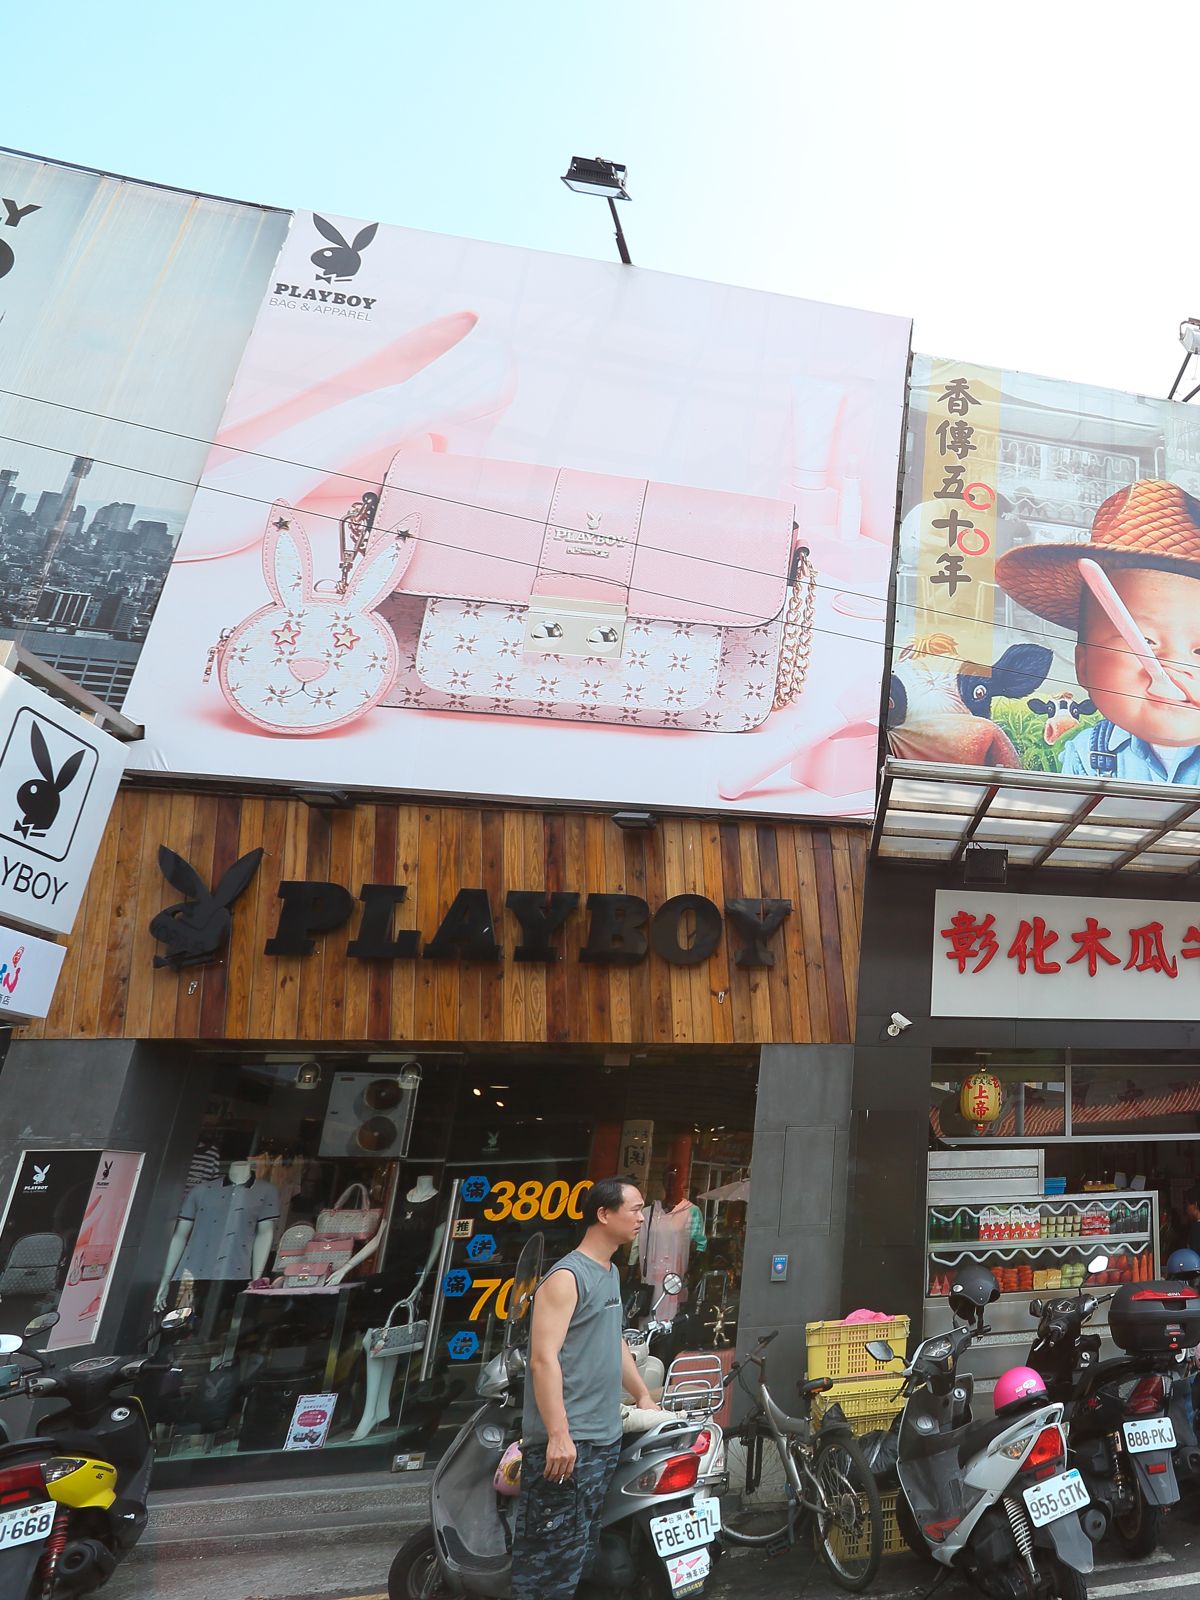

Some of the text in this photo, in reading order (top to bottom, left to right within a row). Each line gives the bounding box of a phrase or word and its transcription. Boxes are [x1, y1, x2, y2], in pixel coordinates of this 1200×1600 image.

[273, 283, 377, 310] PLAYBOY
[268, 298, 297, 310] BAG
[313, 305, 372, 322] APPAREL
[264, 880, 792, 967] PLAYBOY
[456, 1220, 470, 1232] 推
